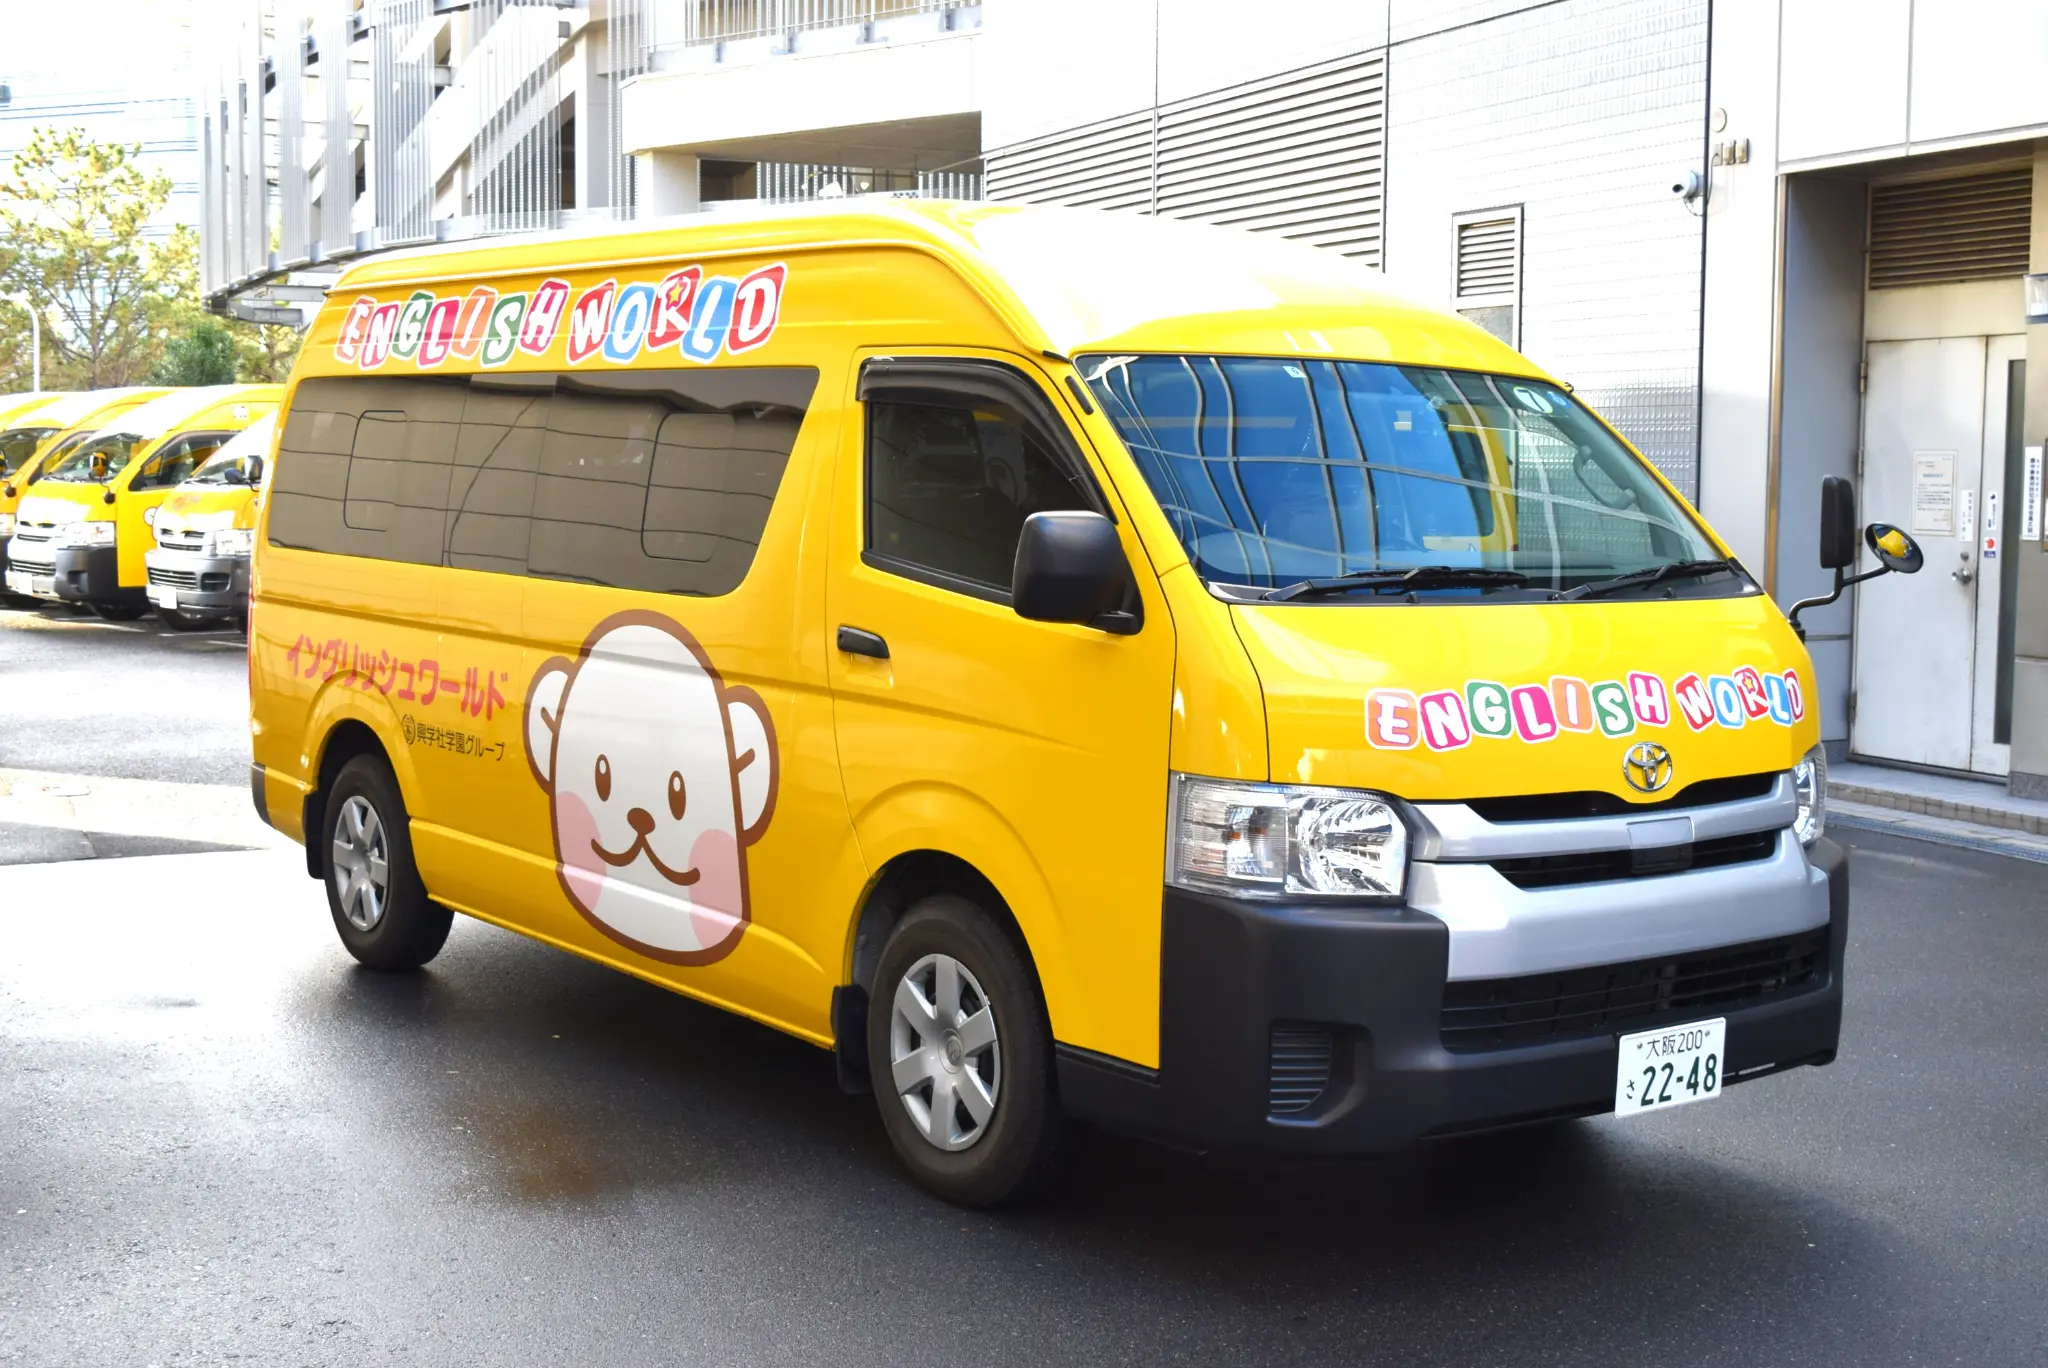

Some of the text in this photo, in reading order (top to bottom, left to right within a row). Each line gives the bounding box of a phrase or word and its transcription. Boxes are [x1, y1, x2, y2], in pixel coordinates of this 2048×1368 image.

[338, 266, 786, 368] ENGLISH WORLD
[287, 634, 508, 720] イングリッシュワールド
[1366, 668, 1804, 750] ENGLISH WORLD
[1640, 1053, 1717, 1107] 22-48
